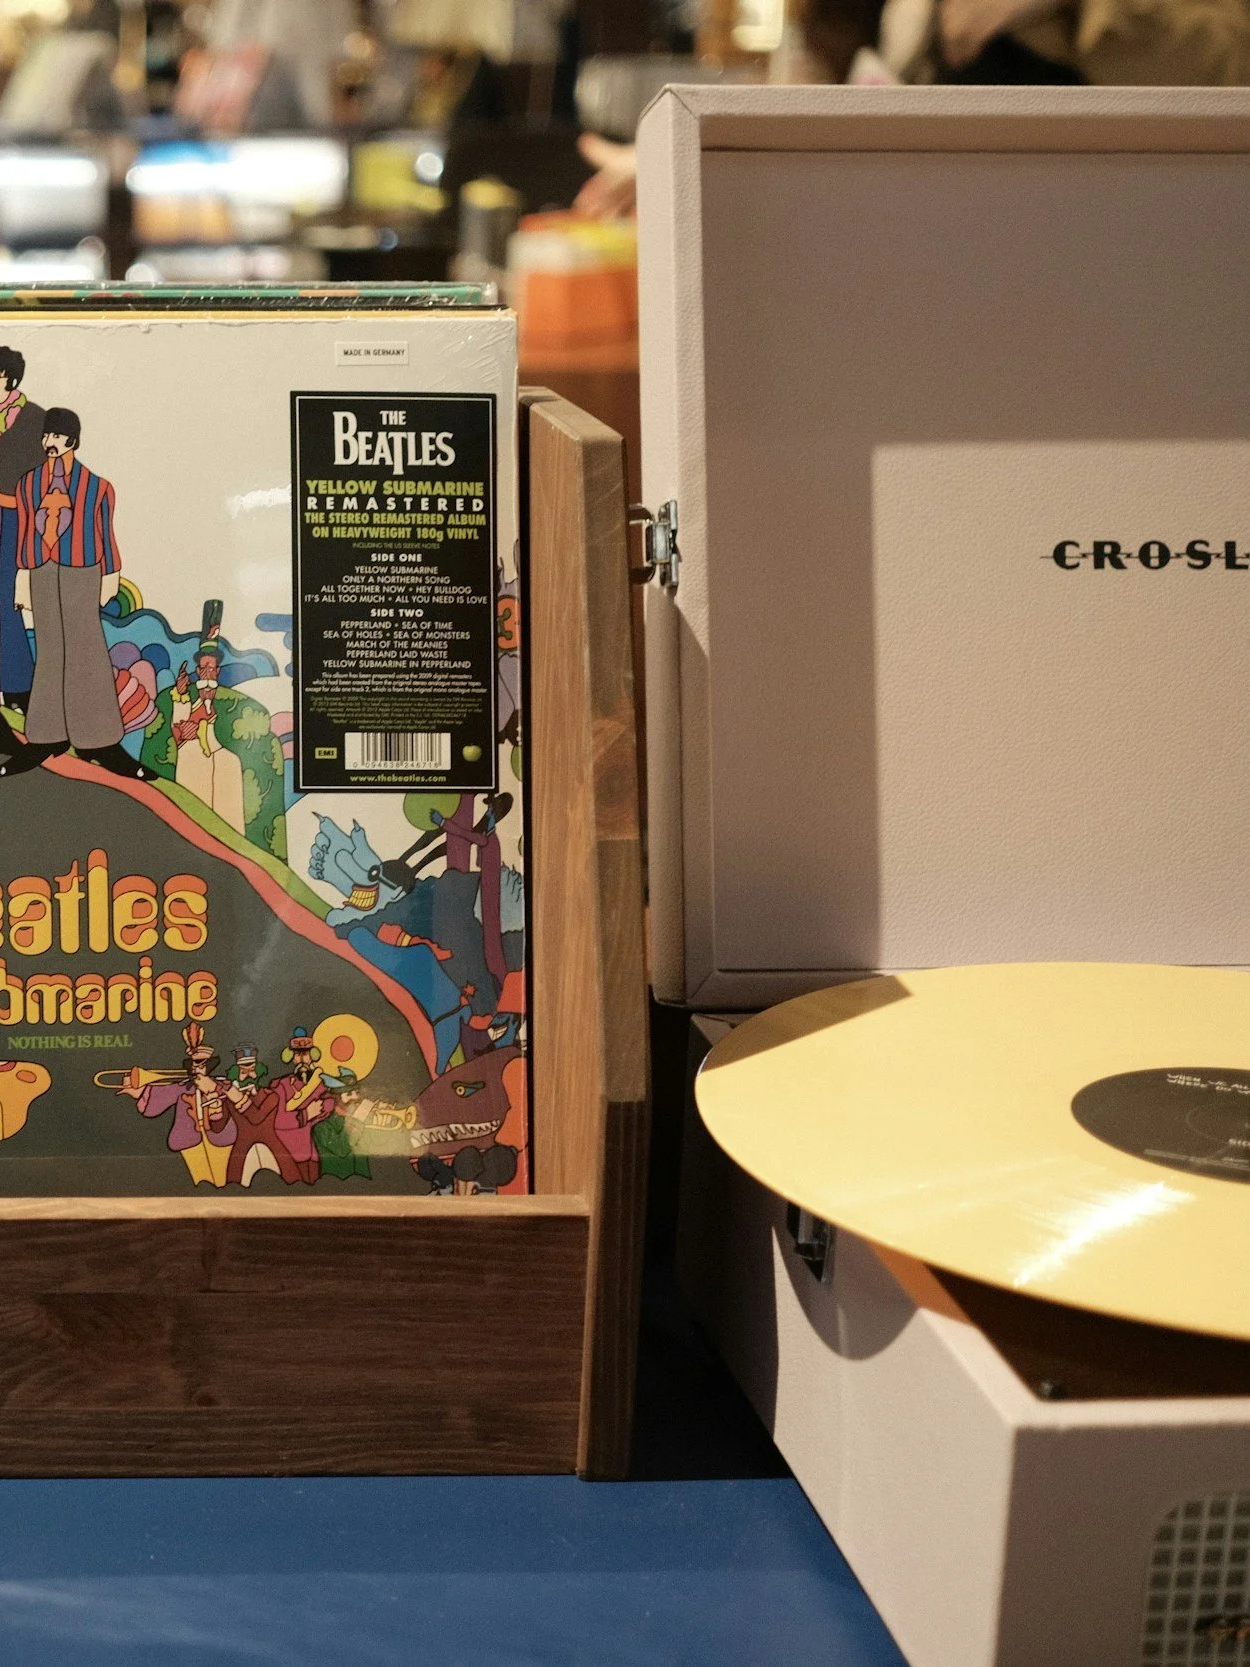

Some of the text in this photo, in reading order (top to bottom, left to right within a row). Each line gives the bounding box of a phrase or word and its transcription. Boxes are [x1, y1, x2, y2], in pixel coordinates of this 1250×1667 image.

[343, 348, 405, 358] MADE IN GERMANY
[379, 410, 406, 425] THE
[332, 411, 456, 475] BEATLES
[306, 480, 484, 497] YELLOW SUBMARINE
[306, 497, 485, 512] REMASTERED
[304, 512, 486, 526] THE STEREO REMASTERED ALBUM
[312, 526, 480, 542] ON HEAVYWEIGHT 180g VINYL
[371, 553, 422, 563] SIDE ONE
[355, 566, 437, 574] YELLOW SUBMARINE
[343, 576, 450, 584] ONLY A NORTHERN SONG
[320, 586, 472, 594] ALL TOGETHER NOW HEY BULLDOG
[304, 595, 487, 604] IT'S ALL TOO MUCH ALL YOU NEED IS LOVE
[370, 609, 424, 618] SIDE TWO
[340, 621, 453, 630] PEPPERLAND SEA OF TIME
[323, 630, 470, 640] SEA OF HOLES SEA OF MONSTERS
[346, 641, 448, 649] MARCH OF THE MEANIES
[346, 650, 447, 659] PEPPERLAND LAID WASTE
[324, 659, 470, 669] YELLOW SUBMARINE IN PEPPERLAND
[349, 773, 447, 782] www.thebeatles.com
[7, 1035, 133, 1049] NOTHING IS REAL
